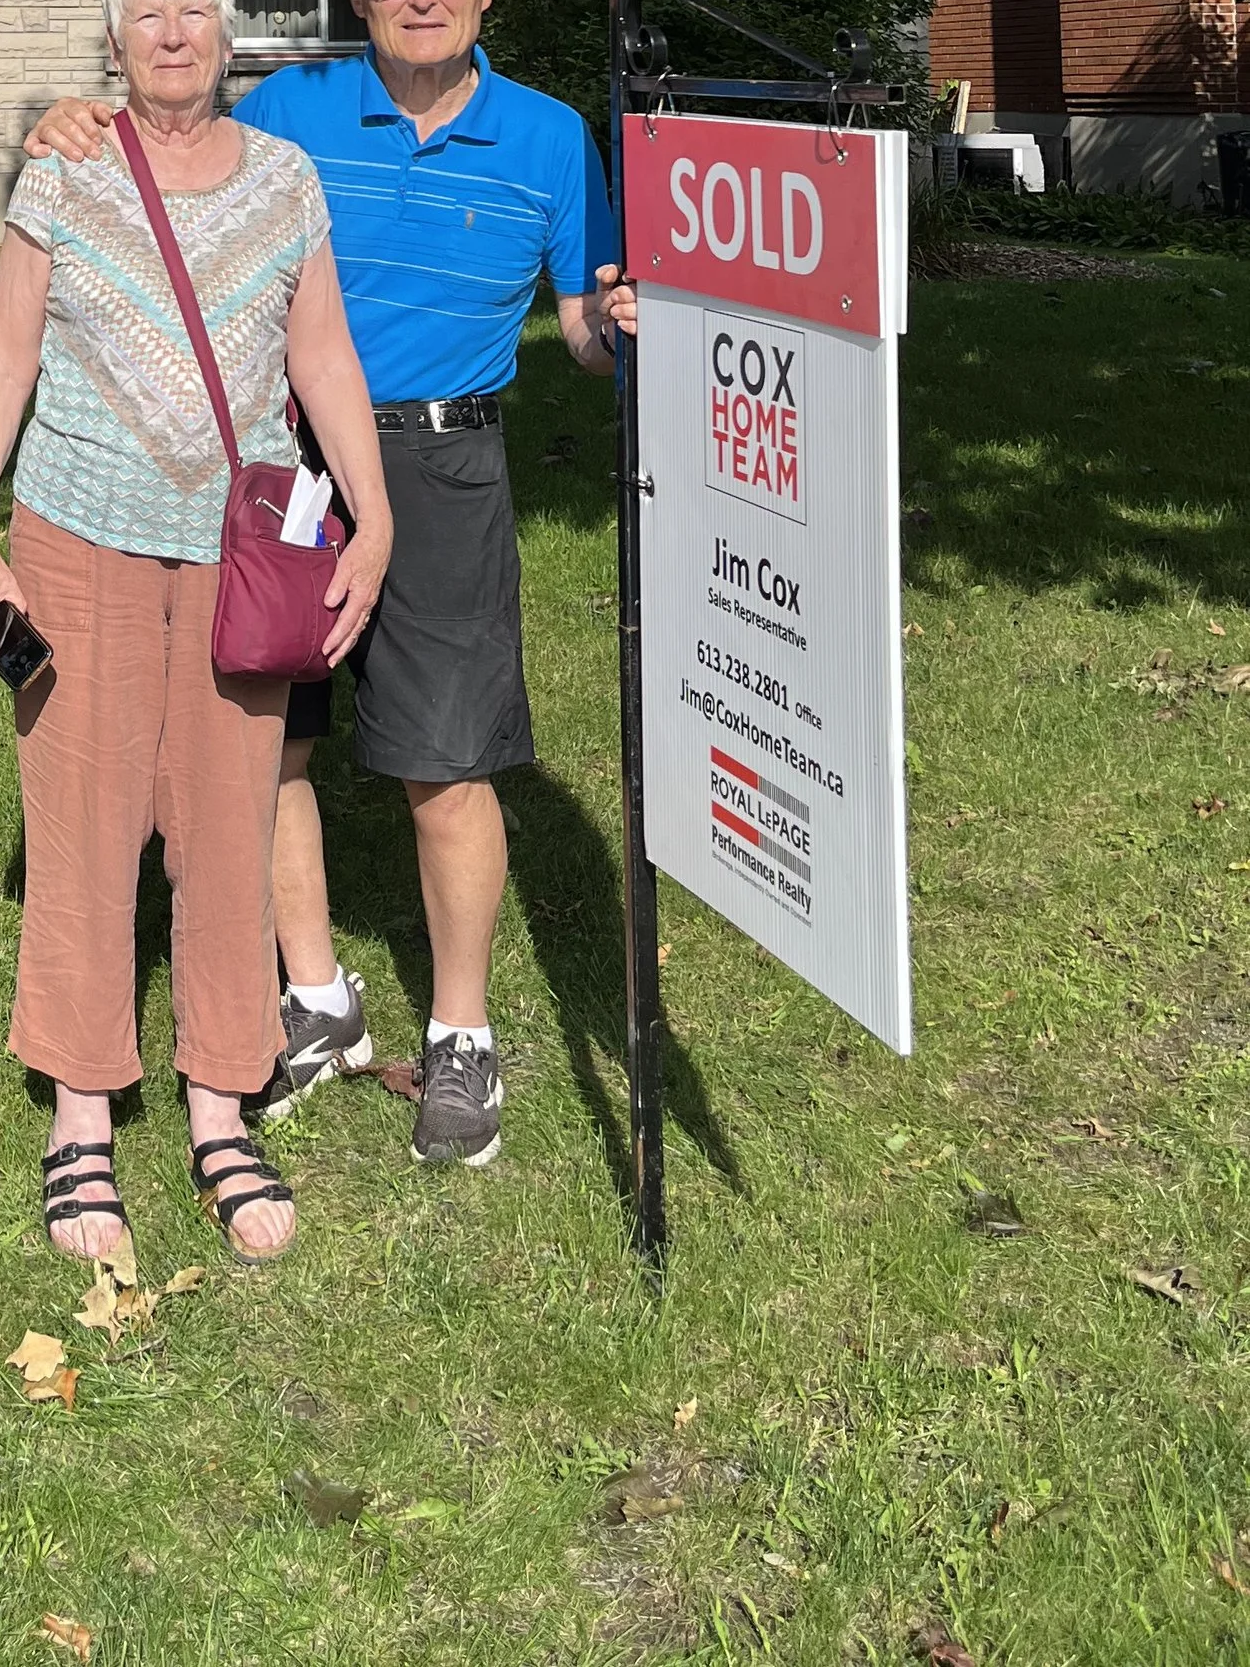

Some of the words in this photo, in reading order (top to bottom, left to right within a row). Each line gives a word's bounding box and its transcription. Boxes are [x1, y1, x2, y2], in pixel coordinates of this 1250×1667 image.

[670, 157, 824, 275] SOLD
[712, 332, 796, 408] COX
[711, 385, 797, 455] HOME
[712, 432, 798, 502] TEAM
[712, 537, 750, 591] Jim
[757, 557, 801, 615] Cox
[708, 587, 731, 613] Sales
[734, 599, 807, 651] Representative
[697, 639, 789, 712] 613.238.2801
[795, 702, 822, 730] Office
[680, 678, 843, 798] Jim@CoxHomeTeam.ca
[711, 770, 755, 819] ROYAL
[712, 824, 775, 886] Performance
[778, 870, 811, 915] Realty
